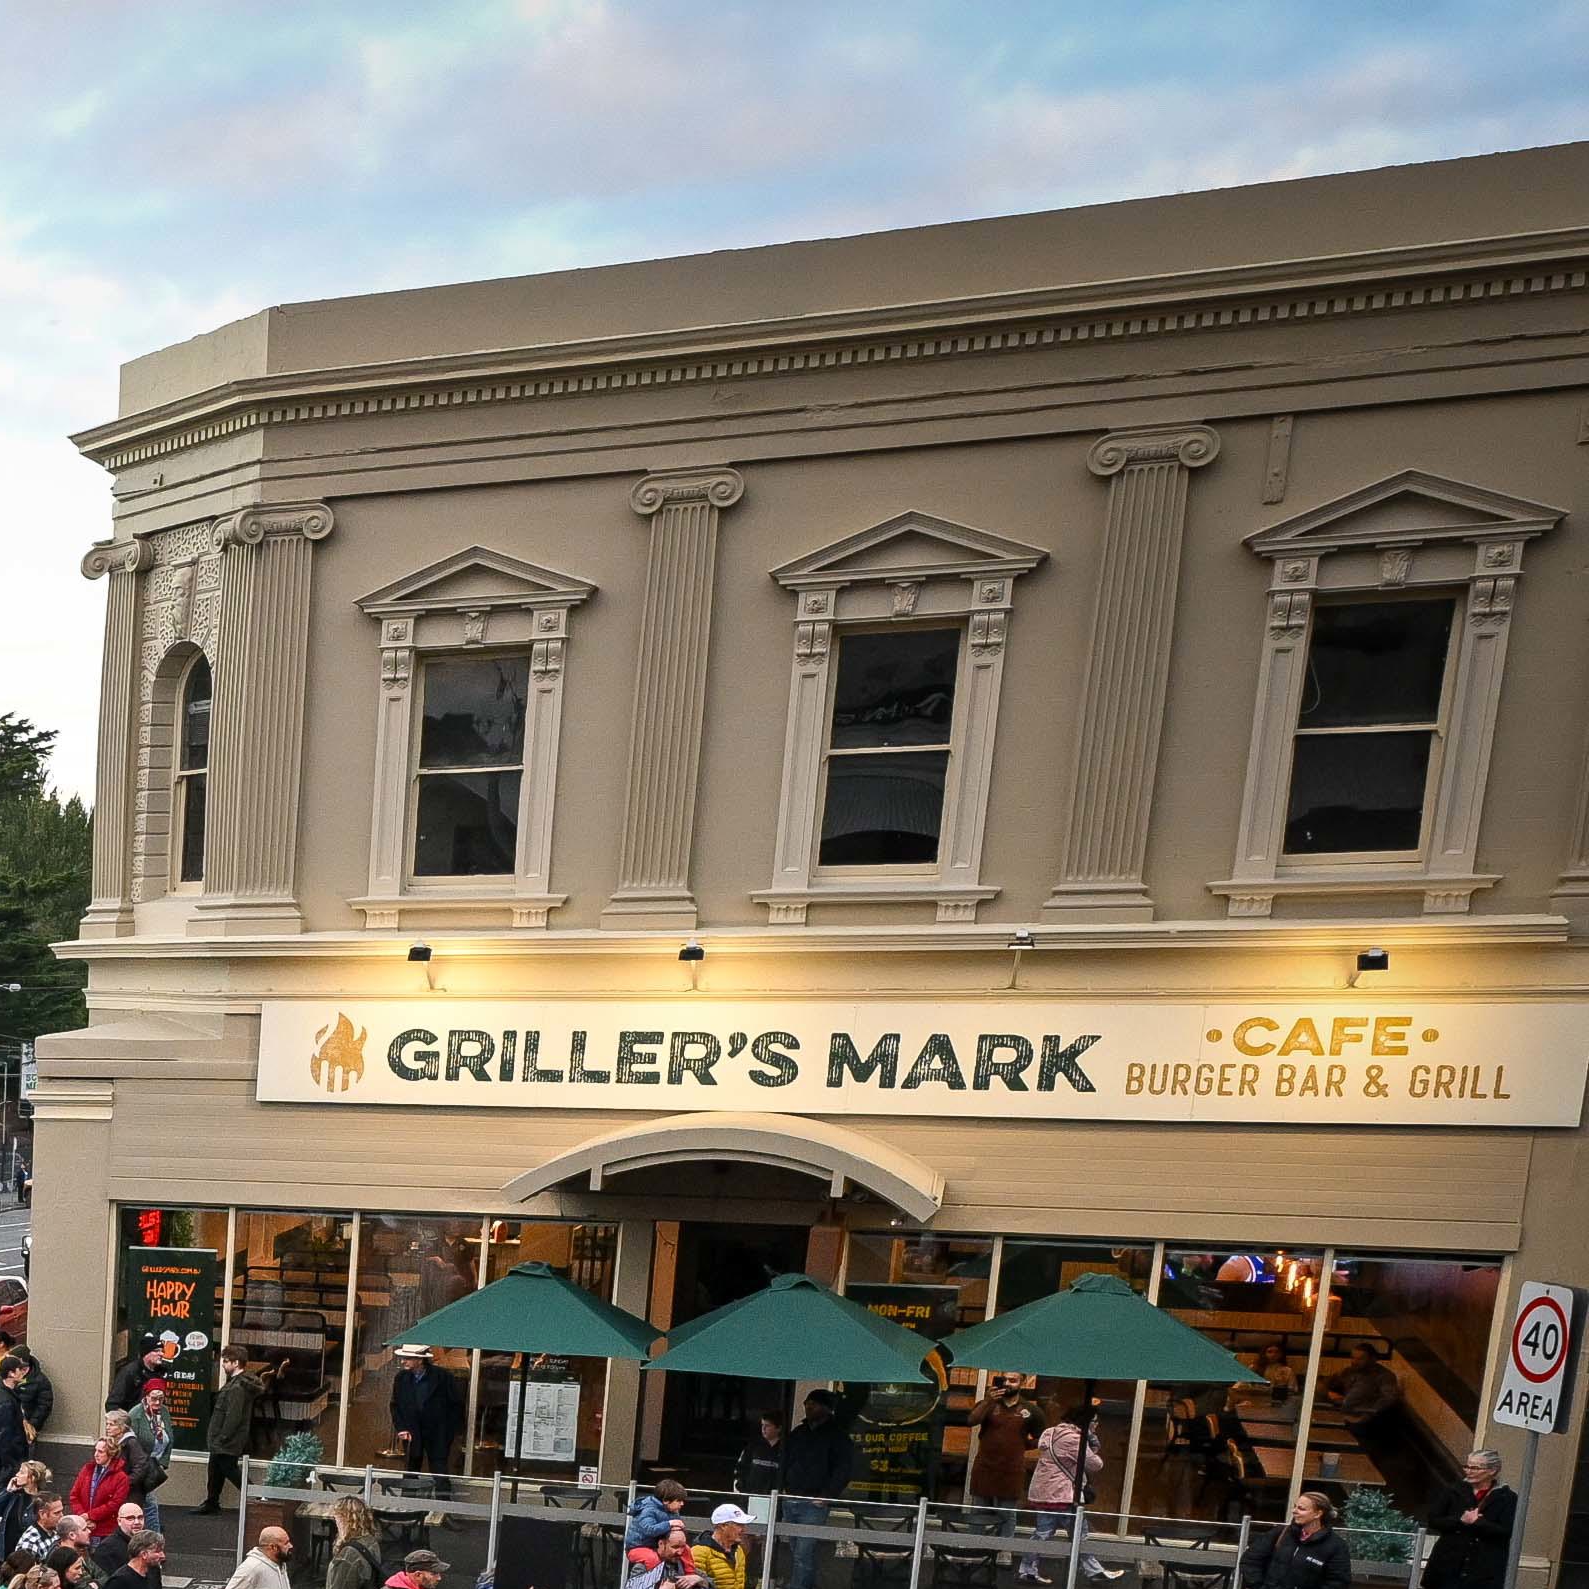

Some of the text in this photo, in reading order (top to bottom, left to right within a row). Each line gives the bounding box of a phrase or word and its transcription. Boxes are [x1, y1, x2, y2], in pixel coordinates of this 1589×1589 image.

[1232, 1016, 1413, 1057] CAFE
[387, 1029, 1102, 1093] GRILLER'S MARK
[1124, 1062, 1512, 1099] BURGER BAR & GRILL
[146, 1280, 196, 1300] HAPPY
[150, 1298, 190, 1319] HOUR
[1522, 1320, 1559, 1361] 40
[1497, 1388, 1553, 1424] AREA
[865, 1433, 886, 1442] OUR
[888, 1432, 929, 1442] COFFEE
